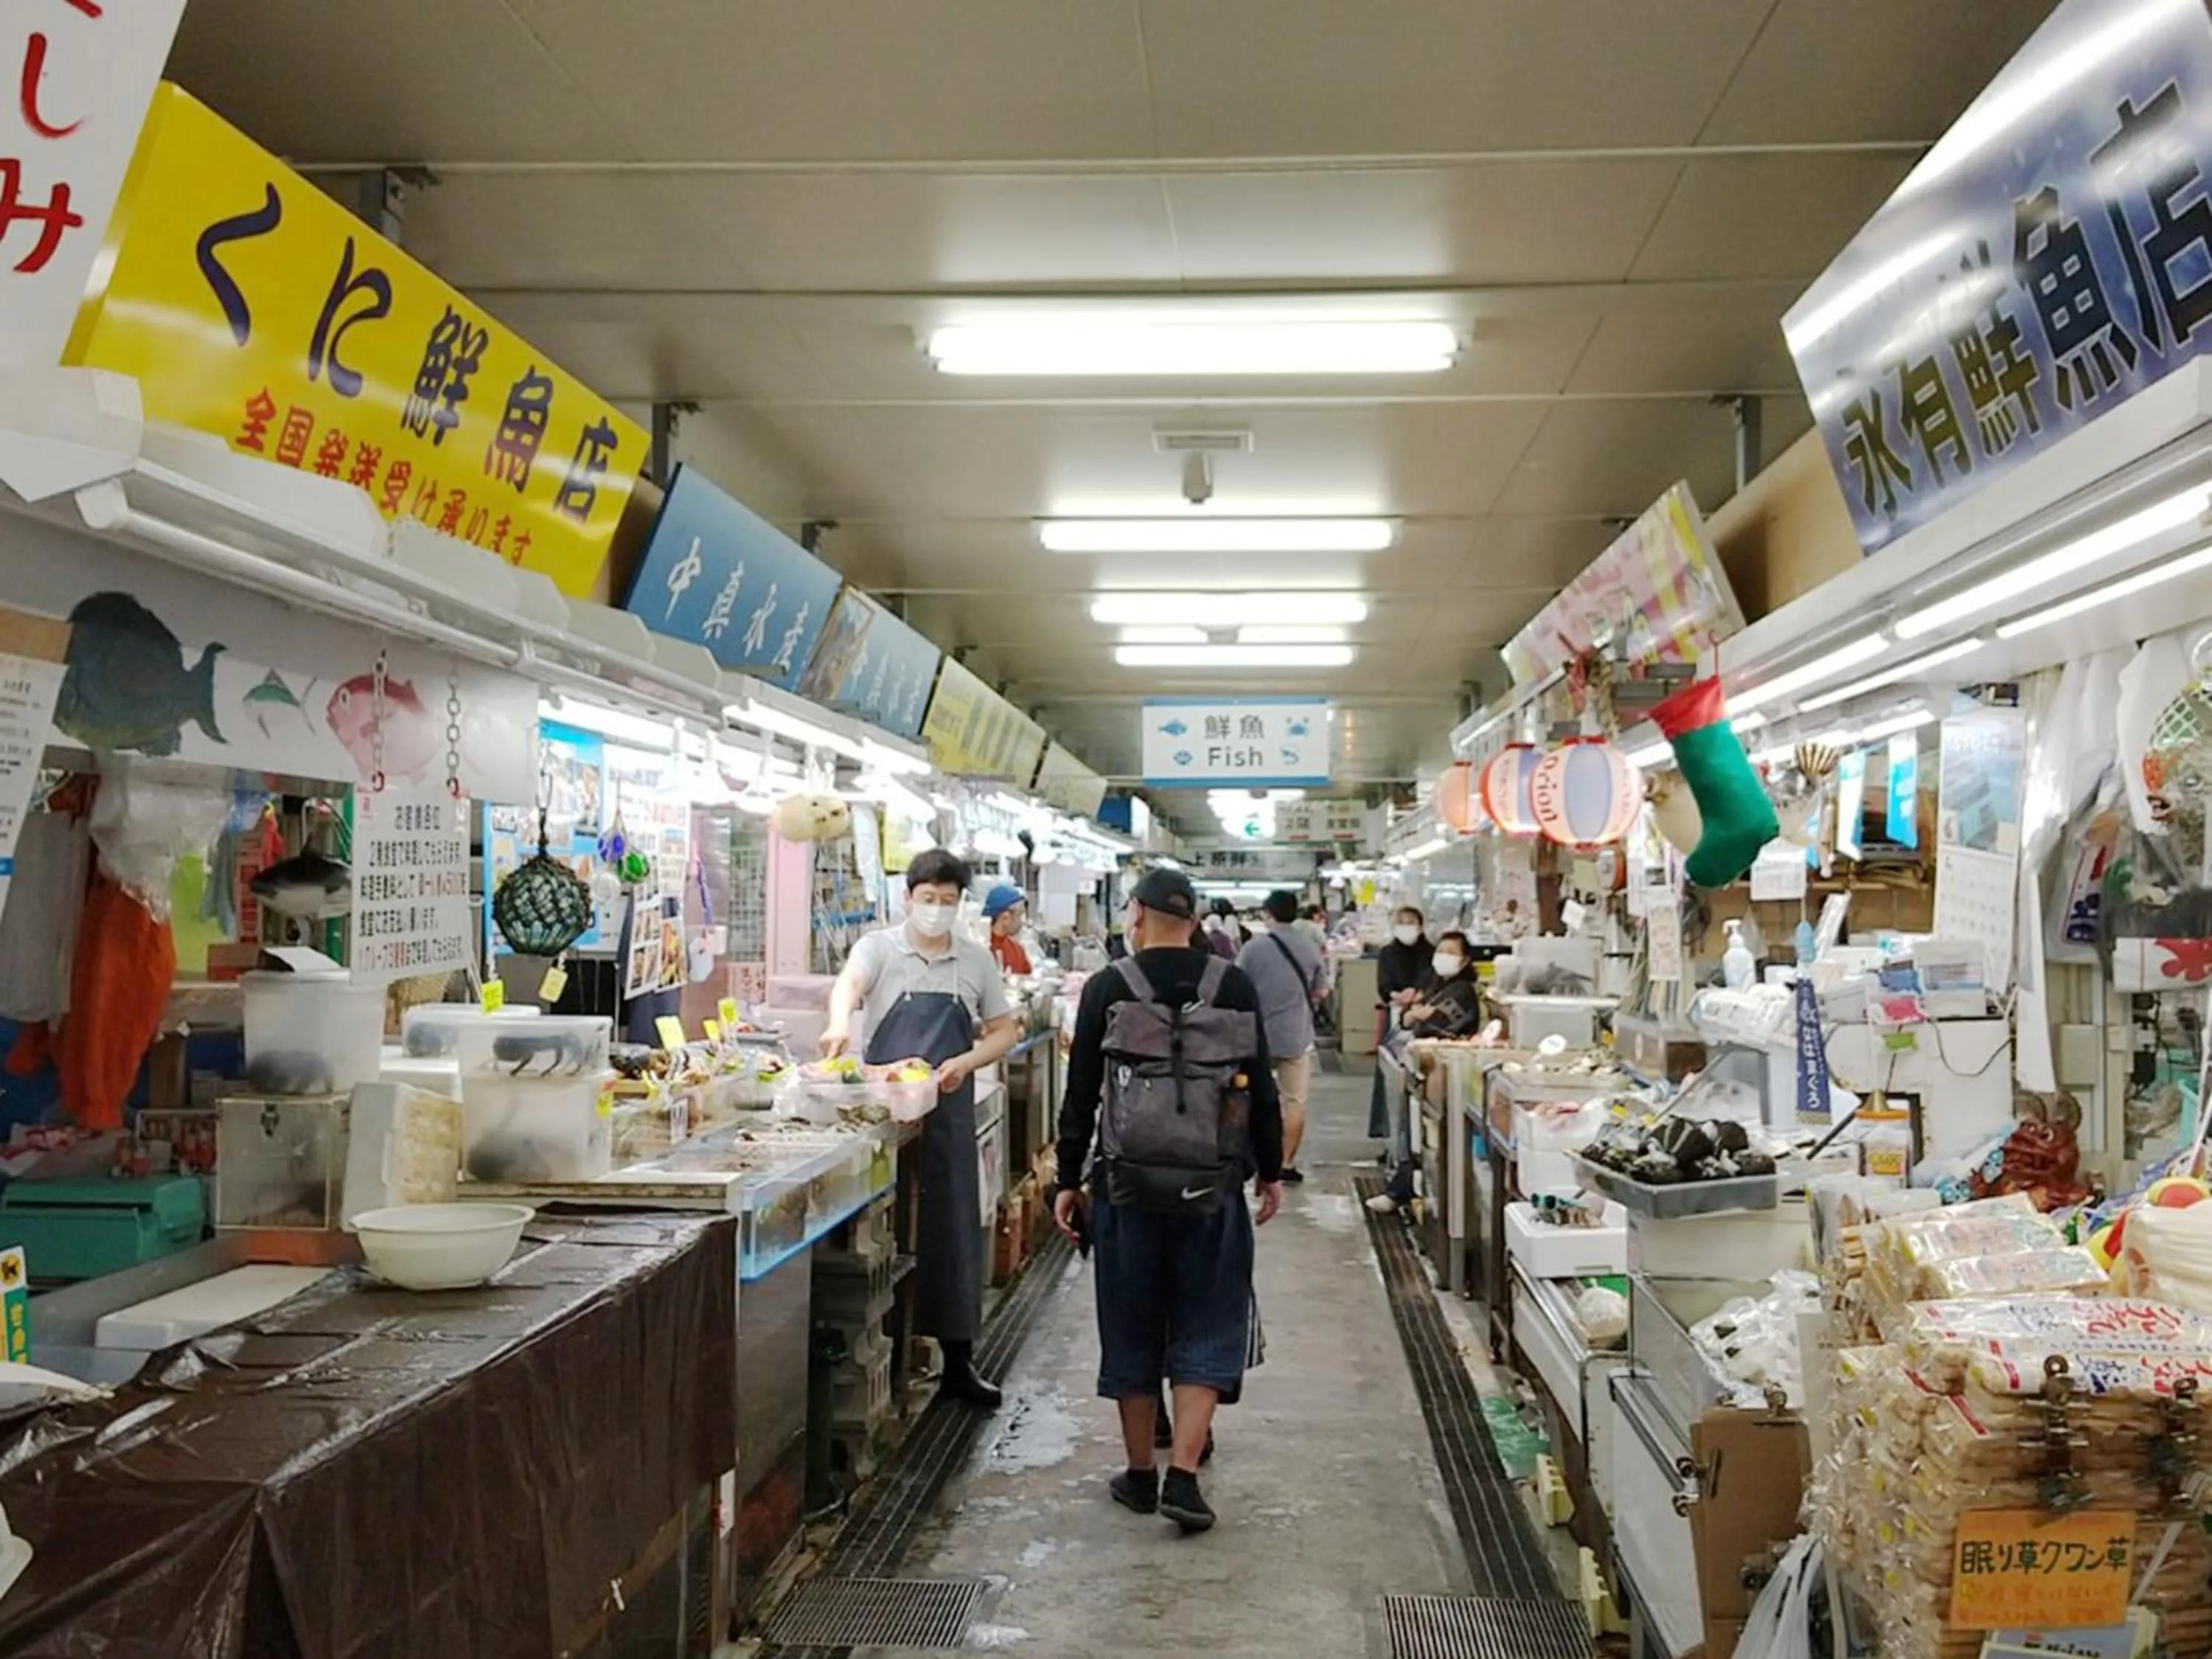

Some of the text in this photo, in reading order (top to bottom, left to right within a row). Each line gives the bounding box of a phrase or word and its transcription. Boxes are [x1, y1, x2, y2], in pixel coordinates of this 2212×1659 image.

[0, 0, 102, 274] しみ
[196, 181, 618, 522] くに鮮魚店
[1204, 714, 1265, 740] 鮮魚
[1208, 746, 1263, 767] Fish
[1960, 1535, 2131, 1576] 眠り草クワン草
